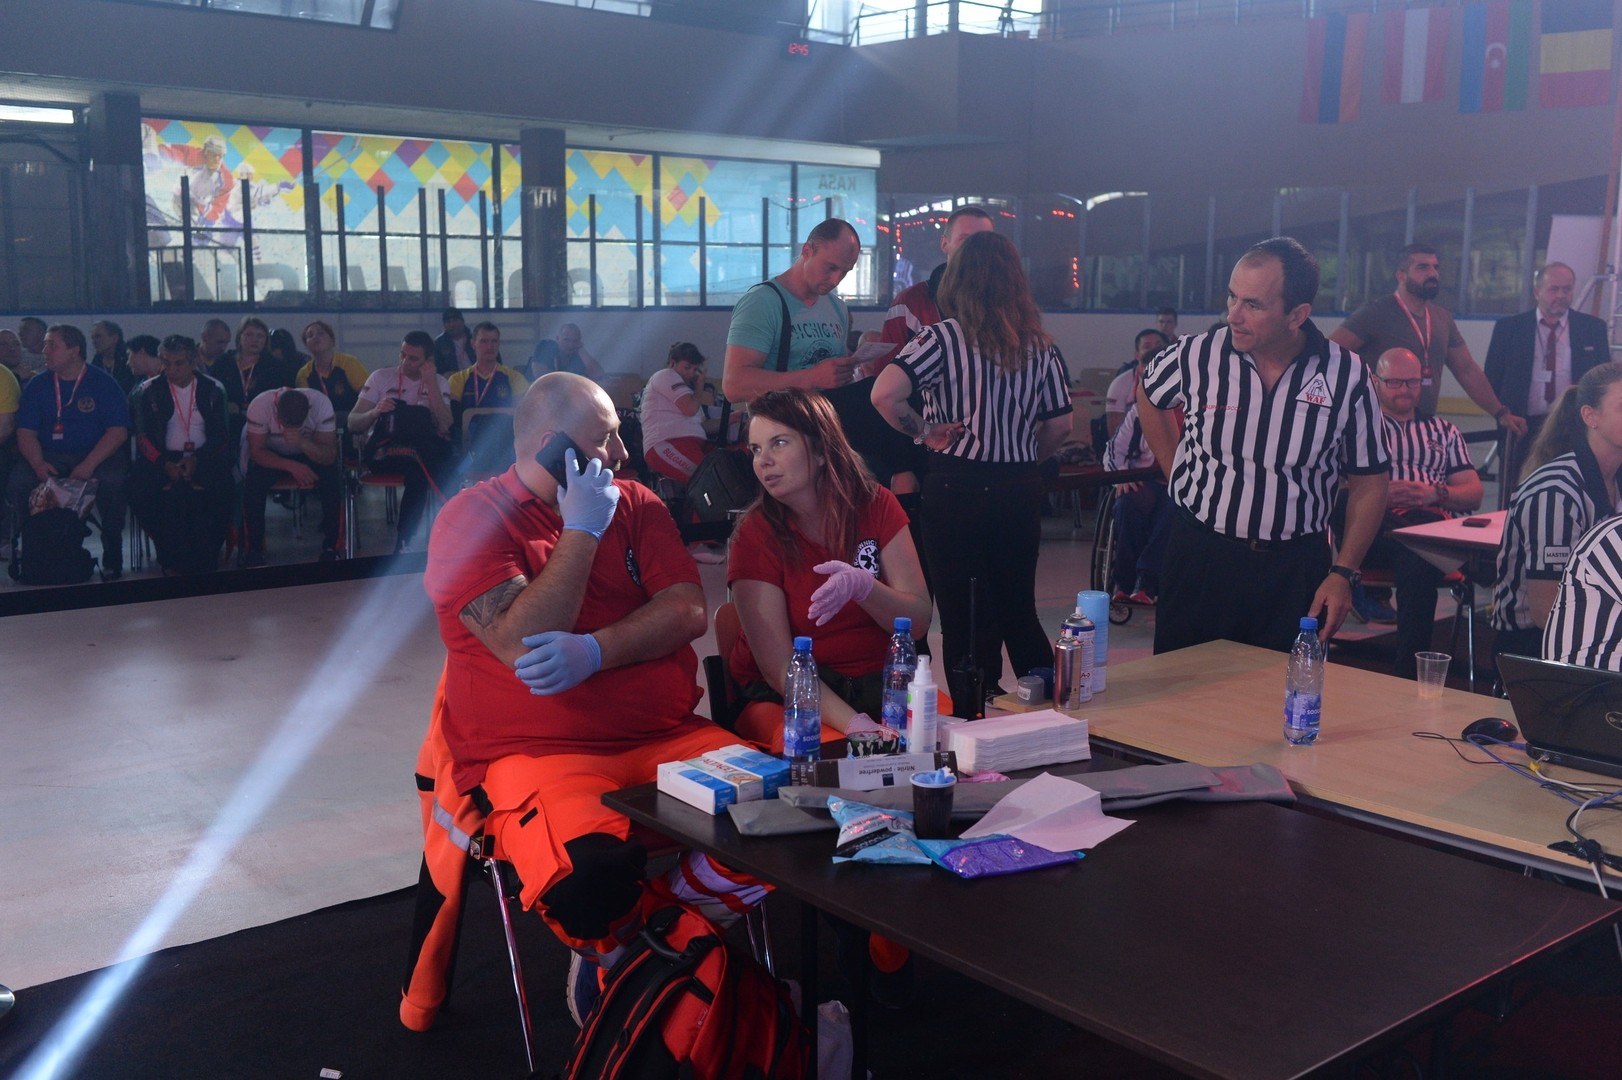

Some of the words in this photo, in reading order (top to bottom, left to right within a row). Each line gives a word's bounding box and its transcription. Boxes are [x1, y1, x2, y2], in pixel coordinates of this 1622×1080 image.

[1305, 393, 1326, 403] WAF
[701, 757, 738, 774] ALTACET
[896, 764, 916, 772] Nitrile
[858, 767, 893, 776] powderfree
